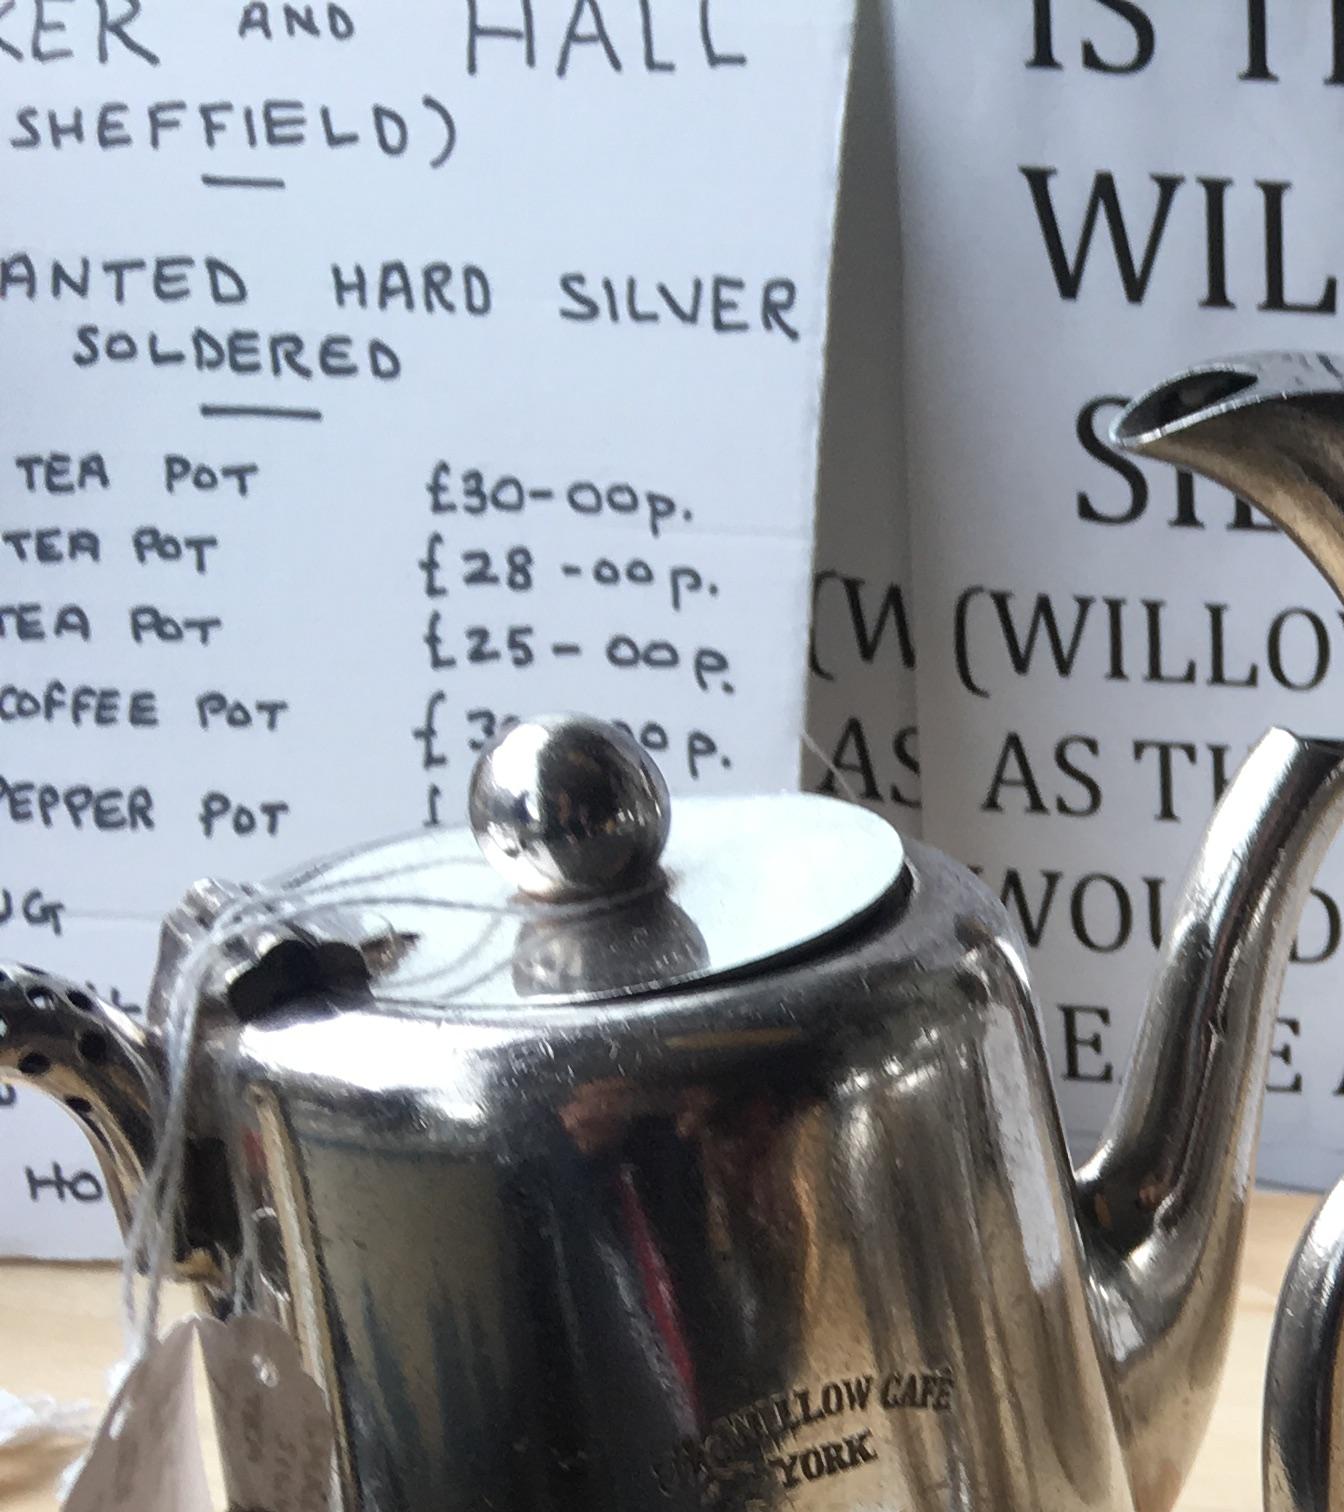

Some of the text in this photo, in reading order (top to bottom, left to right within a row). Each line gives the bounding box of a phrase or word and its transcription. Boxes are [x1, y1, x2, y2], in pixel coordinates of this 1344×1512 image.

[238, 1, 355, 41] AND
[467, 0, 747, 77] HALL
[10, 95, 458, 168] SHEFFIELD)
[331, 261, 492, 316] HARD
[559, 273, 801, 343] SILVER
[72, 325, 402, 381] SOLDERED
[14, 452, 111, 494] TEA
[163, 453, 260, 498] POT
[1, 527, 102, 564] TEA
[131, 525, 219, 576] POT
[129, 604, 224, 647] POT
[0, 679, 159, 728] COFFEE
[195, 690, 290, 732] POT
[980, 730, 1103, 818] AS
[200, 790, 290, 839] POT
[767, 1427, 879, 1490] YORK
